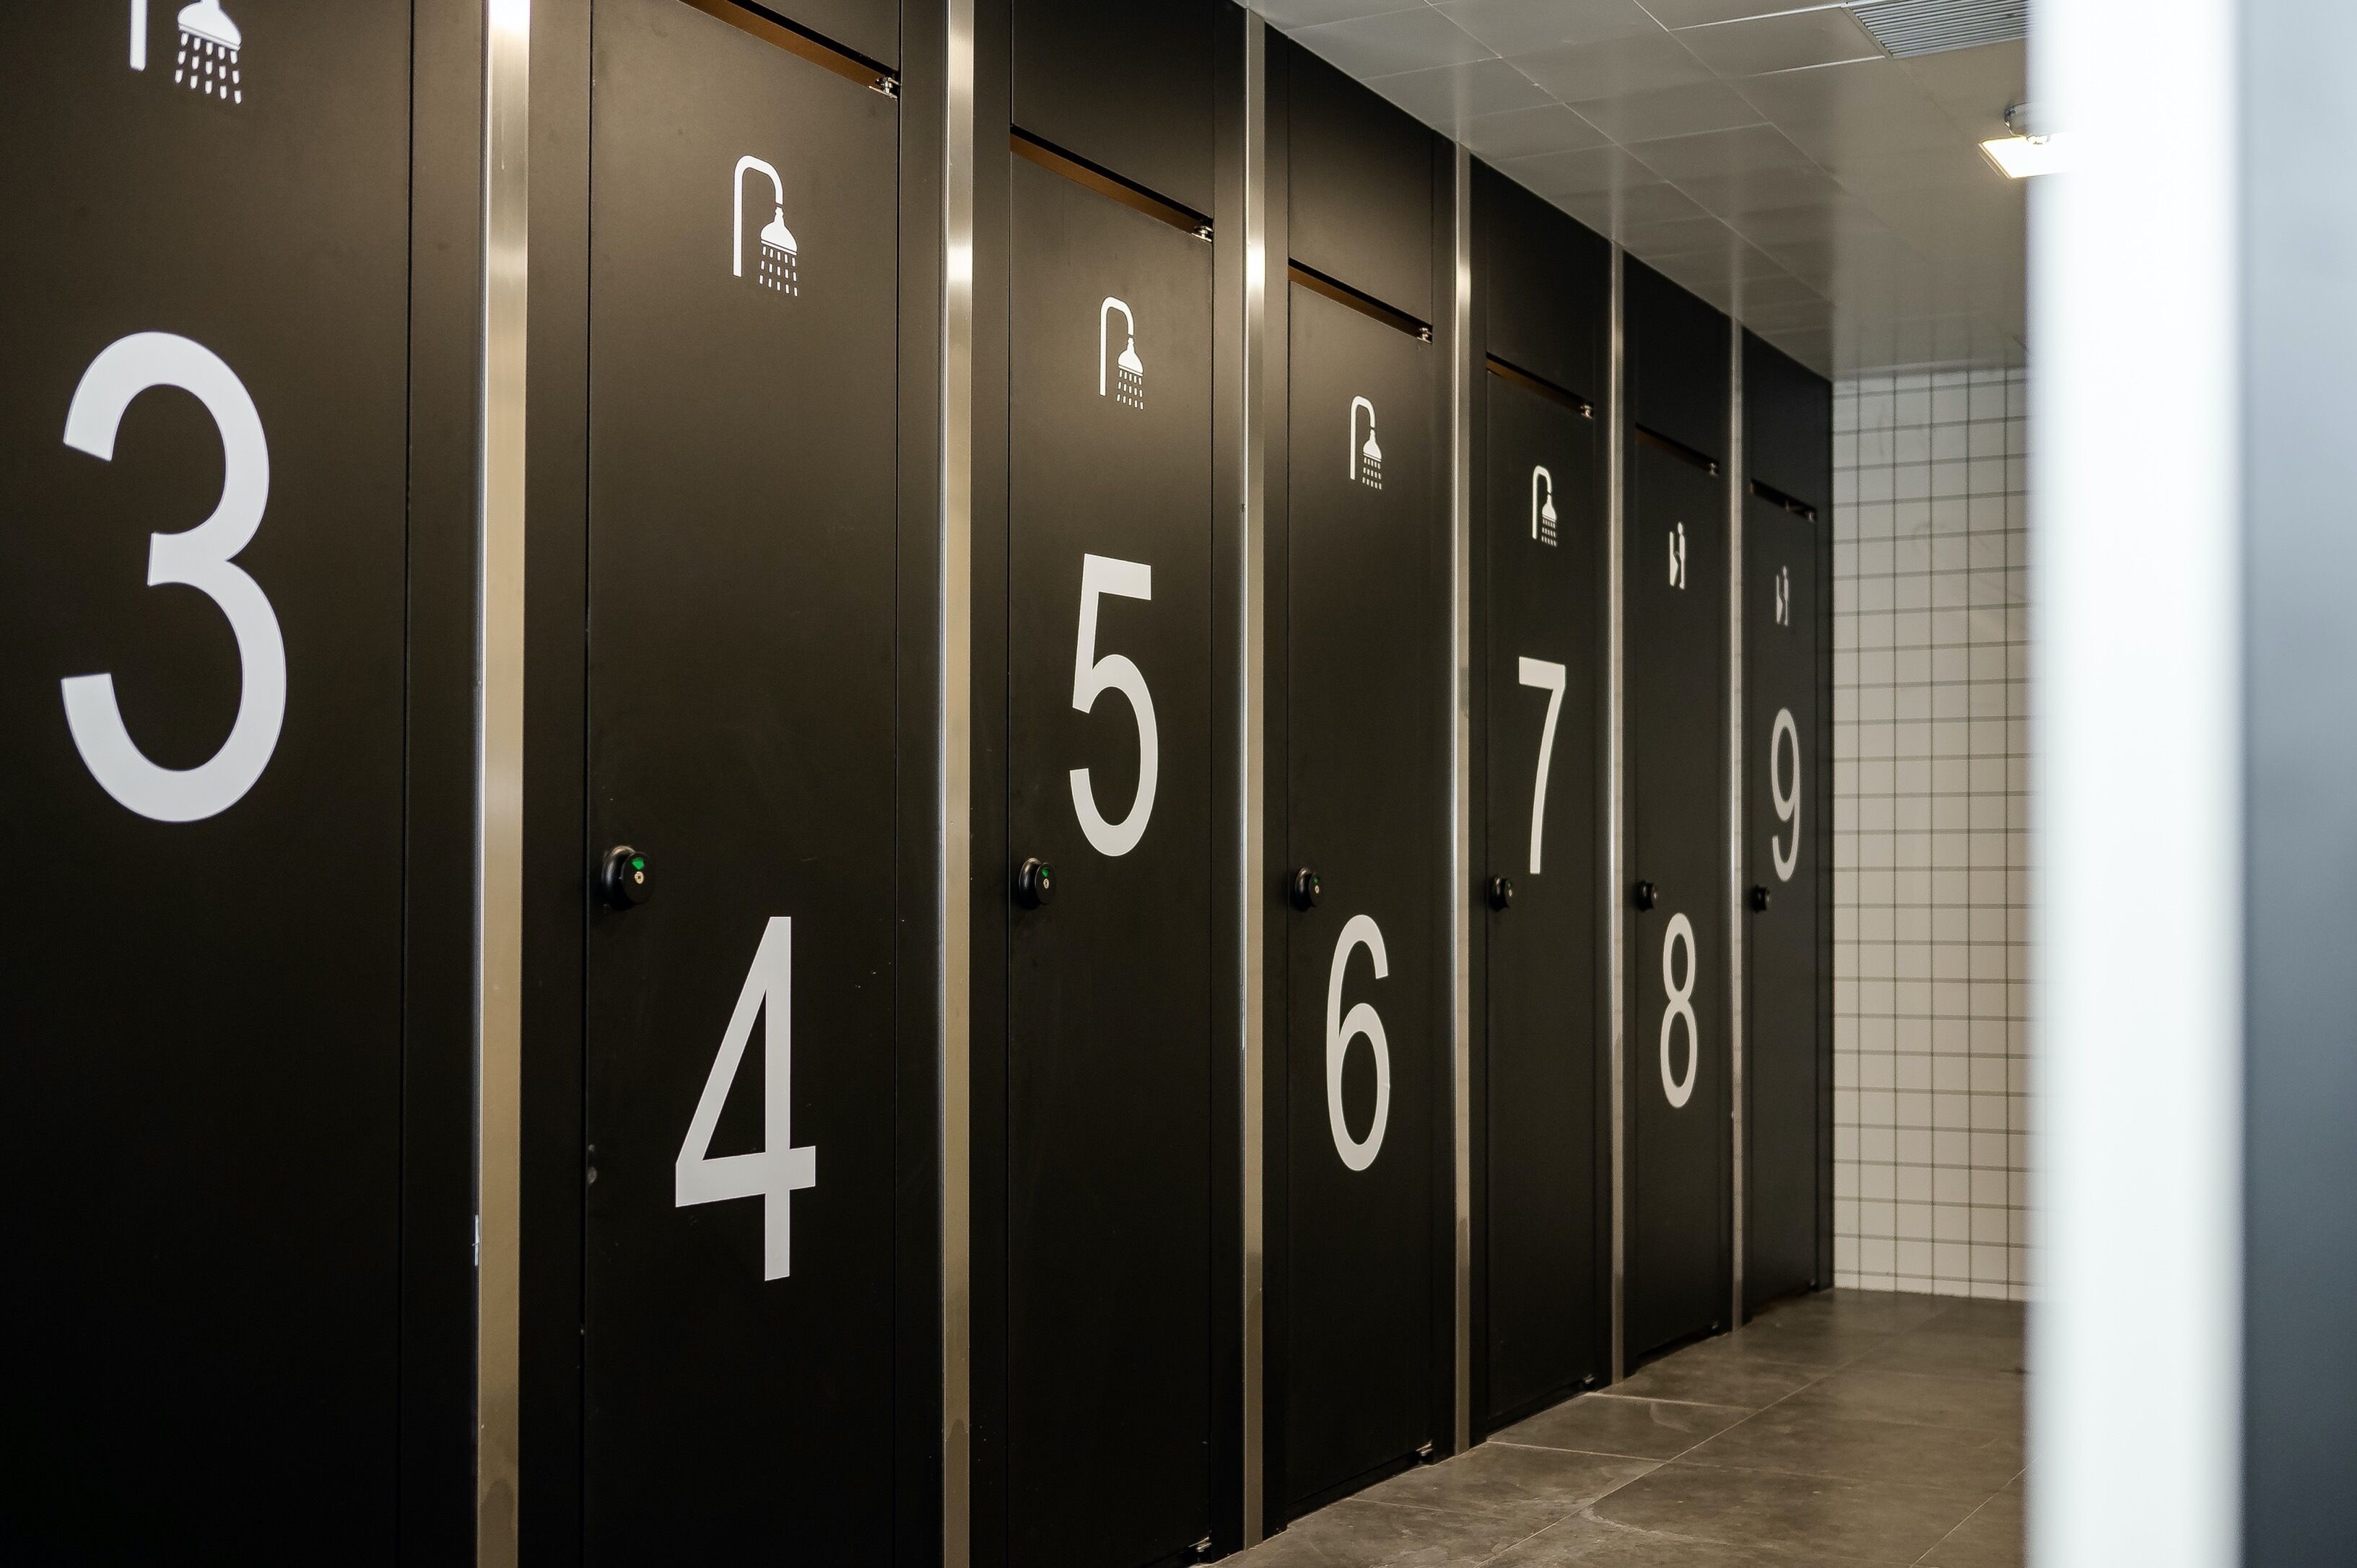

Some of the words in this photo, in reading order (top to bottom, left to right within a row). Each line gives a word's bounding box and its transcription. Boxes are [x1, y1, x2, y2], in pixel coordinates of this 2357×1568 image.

[61, 331, 287, 822] 3
[1069, 553, 1159, 857] 5
[1518, 655, 1567, 875] 7
[1770, 708, 1800, 881] 9
[675, 916, 816, 1282] 4
[1326, 914, 1390, 1172] 6
[1660, 913, 1698, 1108] 8
